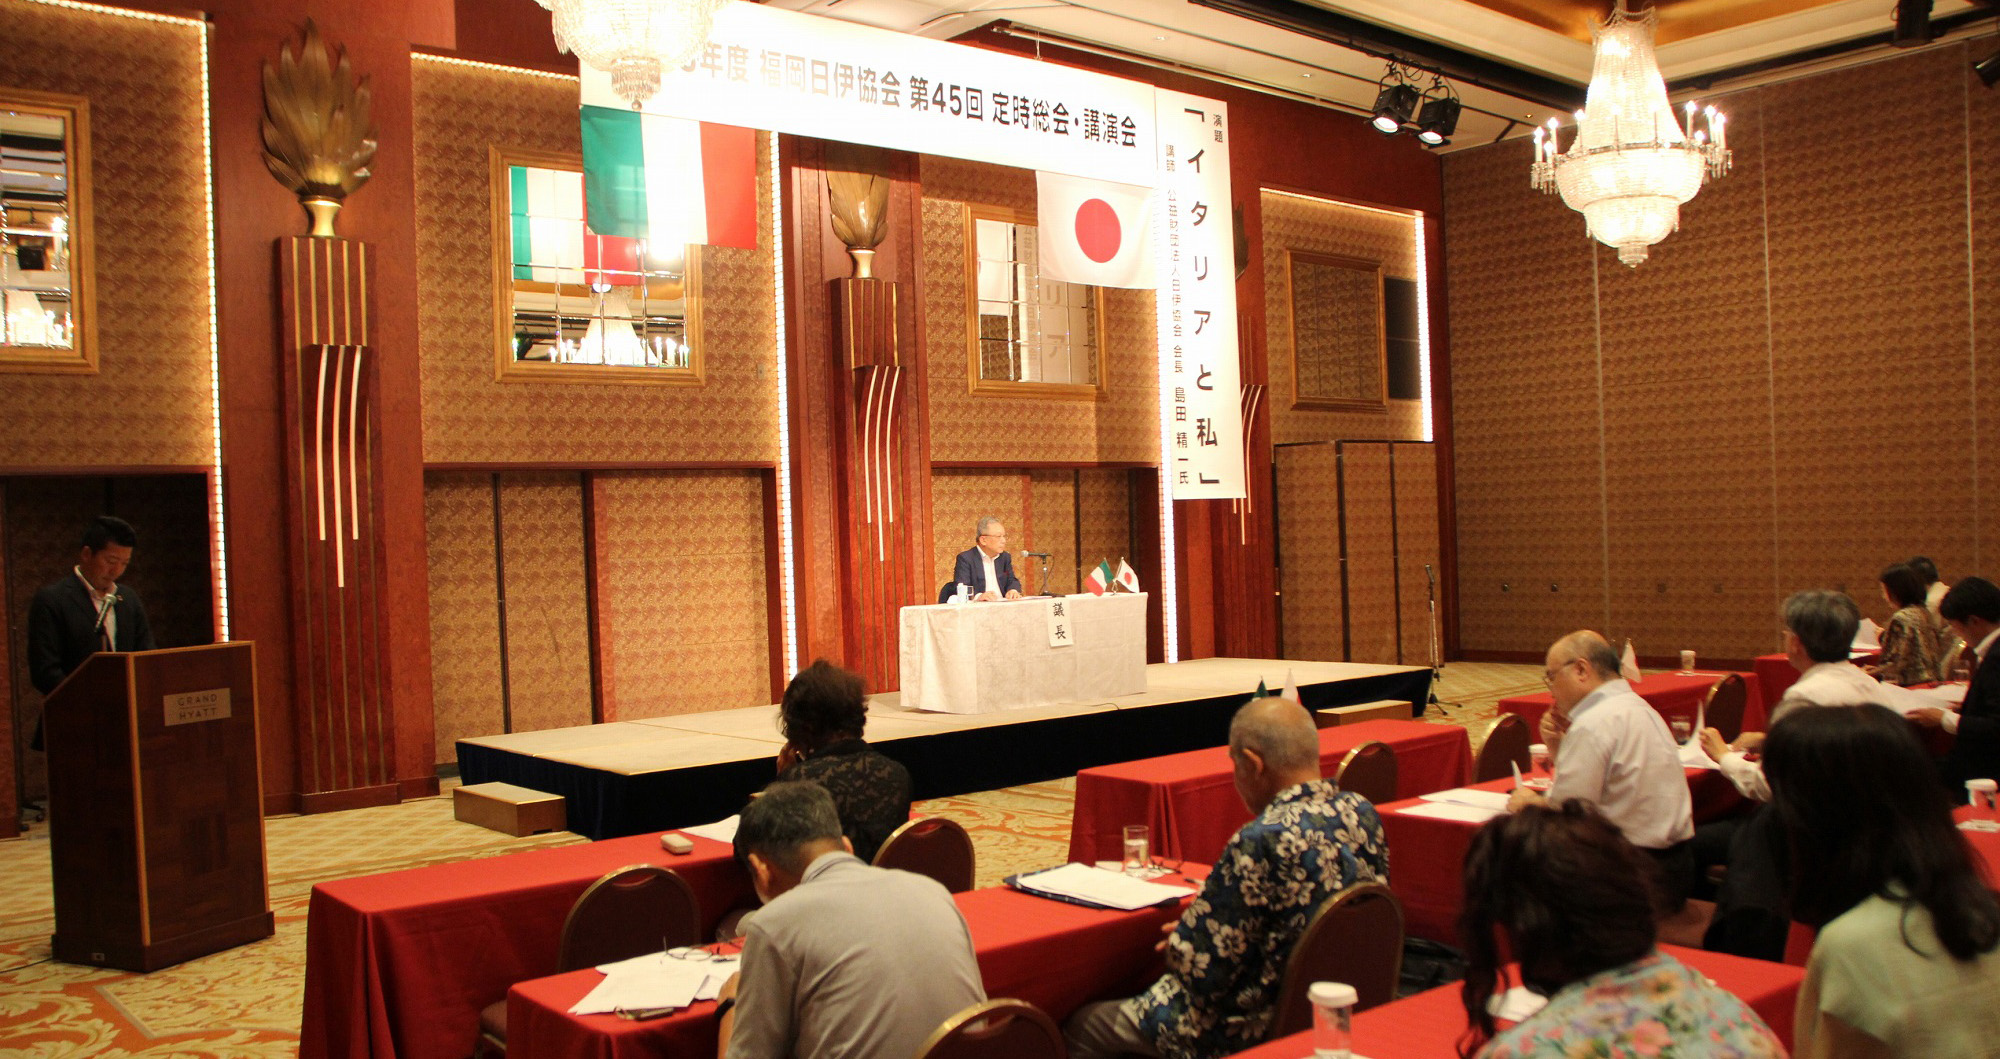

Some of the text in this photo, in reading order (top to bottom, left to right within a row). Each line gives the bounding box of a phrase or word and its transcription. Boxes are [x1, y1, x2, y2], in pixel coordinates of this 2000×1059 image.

[759, 48, 901, 108] 福岡日伊協会
[909, 76, 984, 122] 第45回
[992, 91, 1138, 149] 定時総会・講演会
[1213, 113, 1224, 144] 演題
[1184, 108, 1220, 484] 「イタリアと私」
[1053, 602, 1066, 639] 議長
[177, 693, 218, 707] GRAND
[179, 707, 217, 720] HYATT
